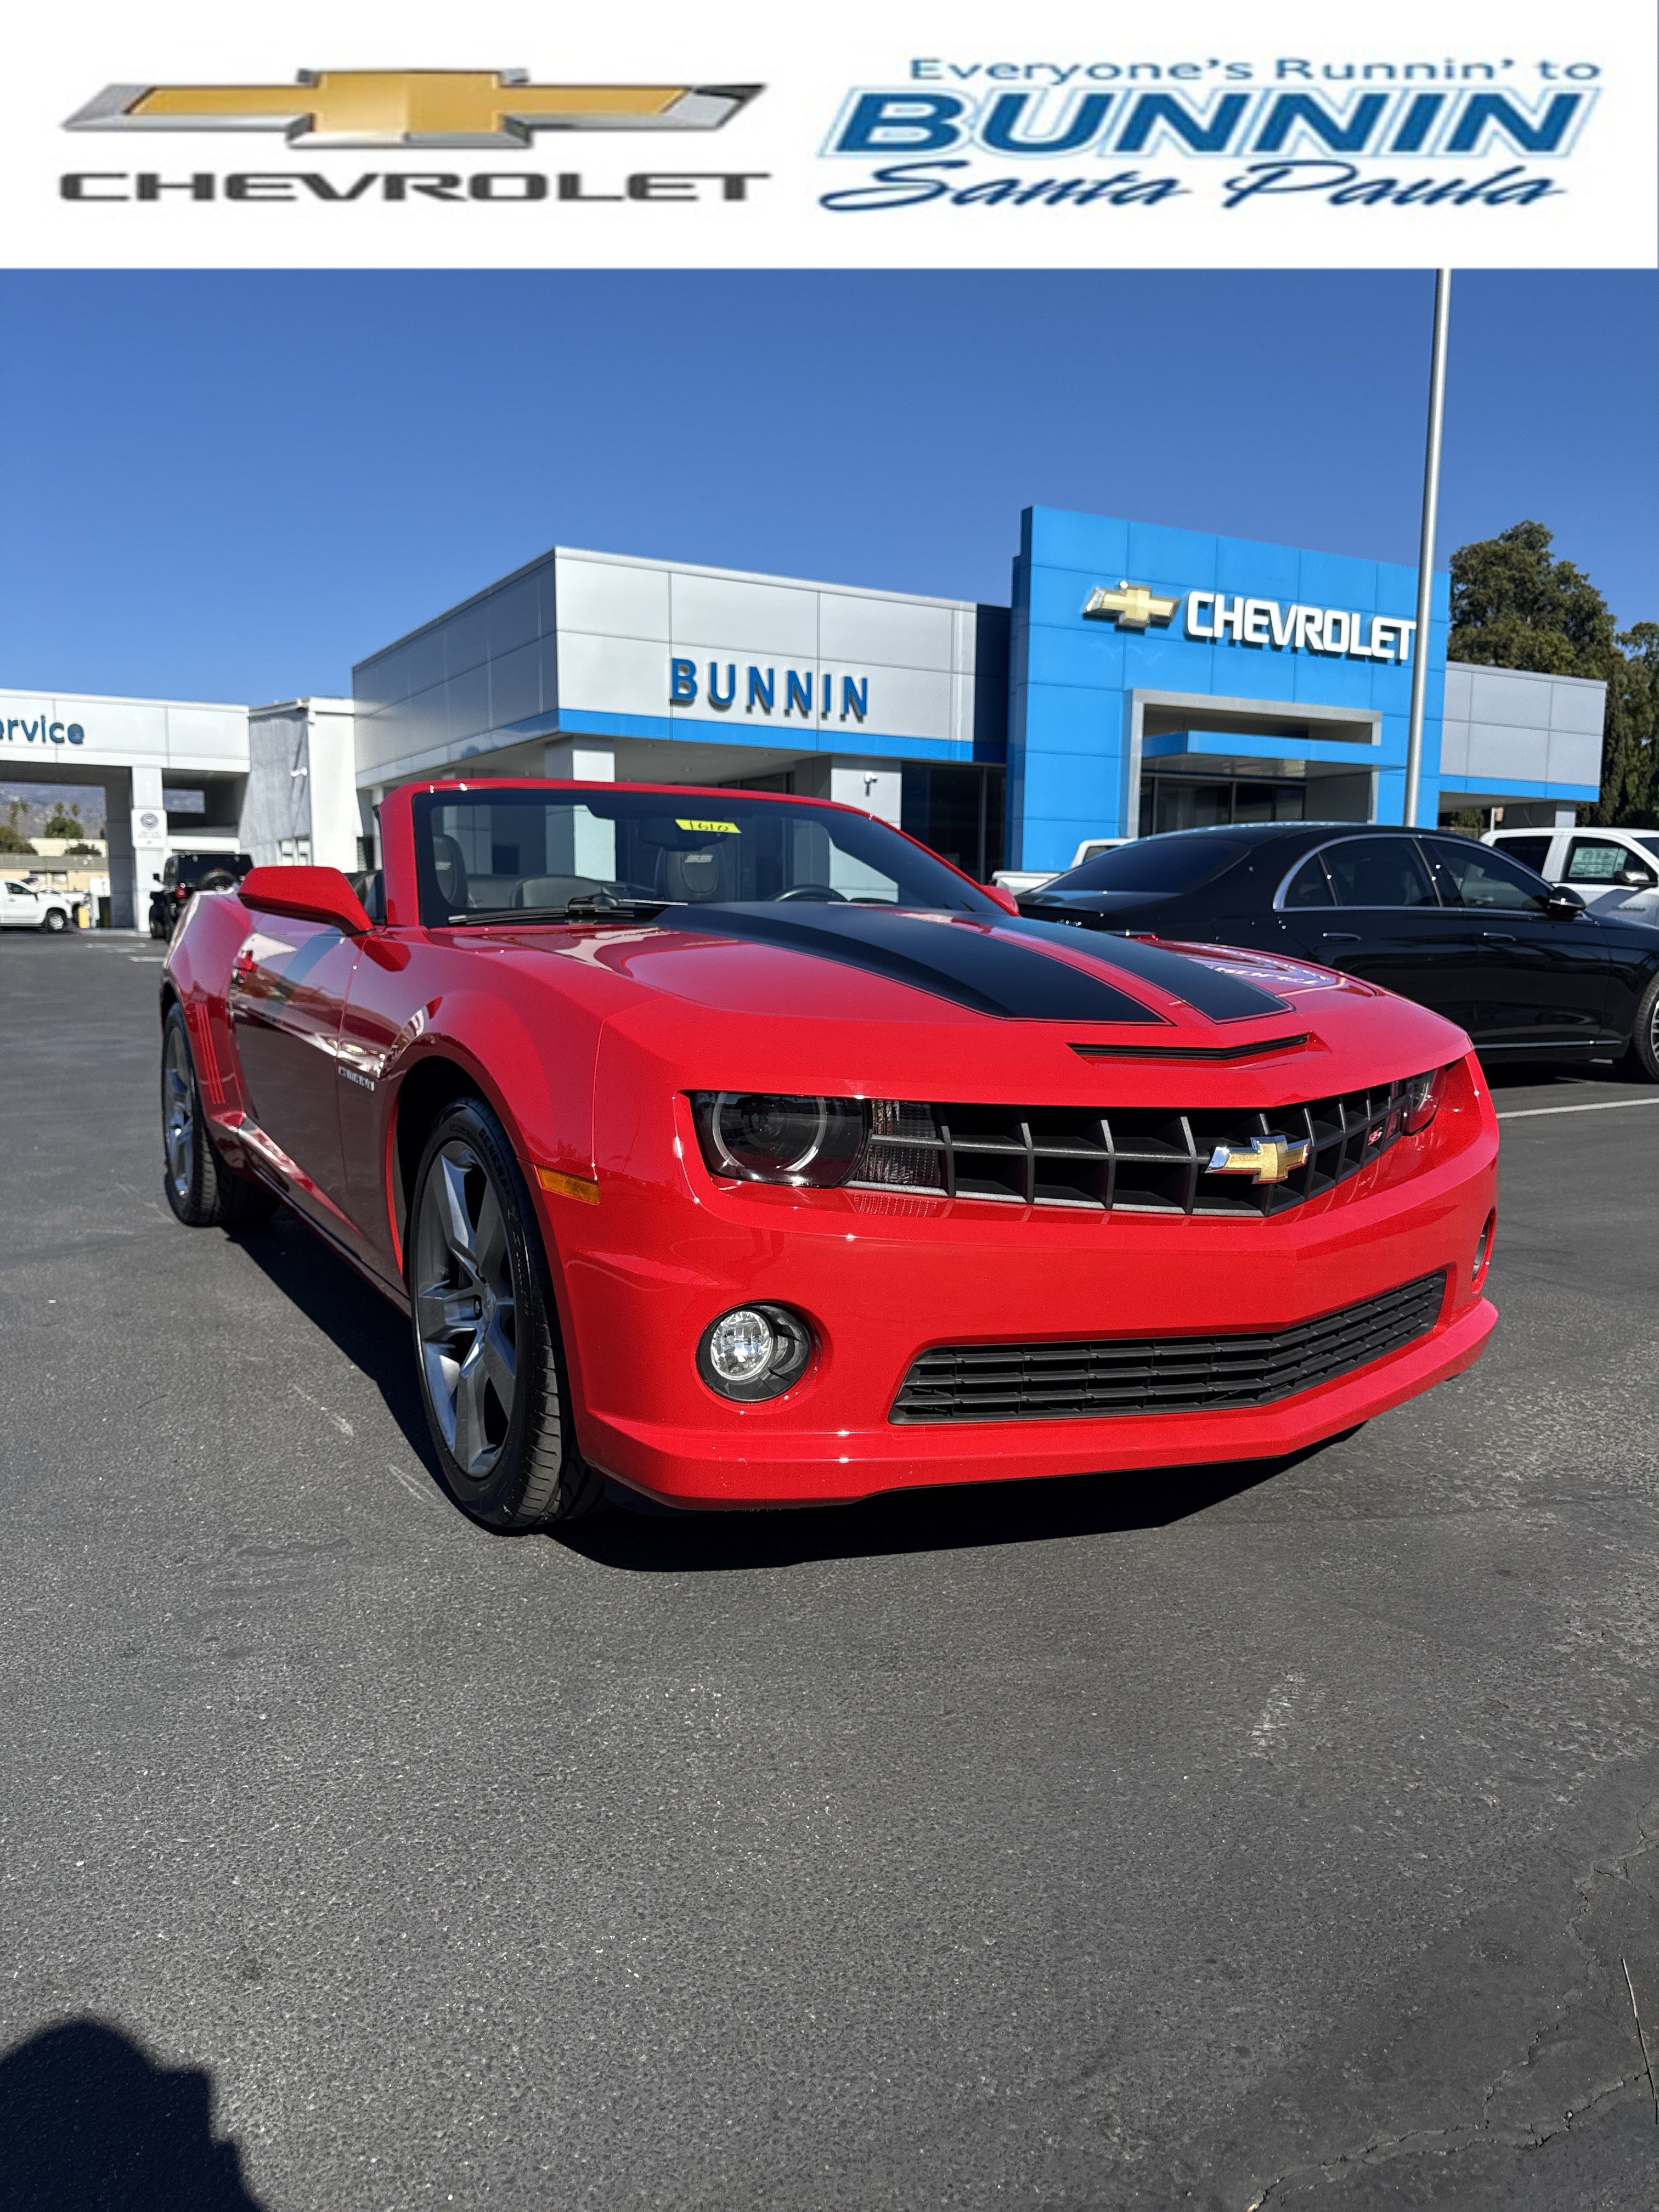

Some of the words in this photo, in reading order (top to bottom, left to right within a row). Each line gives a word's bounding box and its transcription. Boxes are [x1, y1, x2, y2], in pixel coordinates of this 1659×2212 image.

[1185, 590, 1417, 661] CHEVROLET
[670, 658, 868, 718] BUNNIN
[0, 715, 84, 744] rvice
